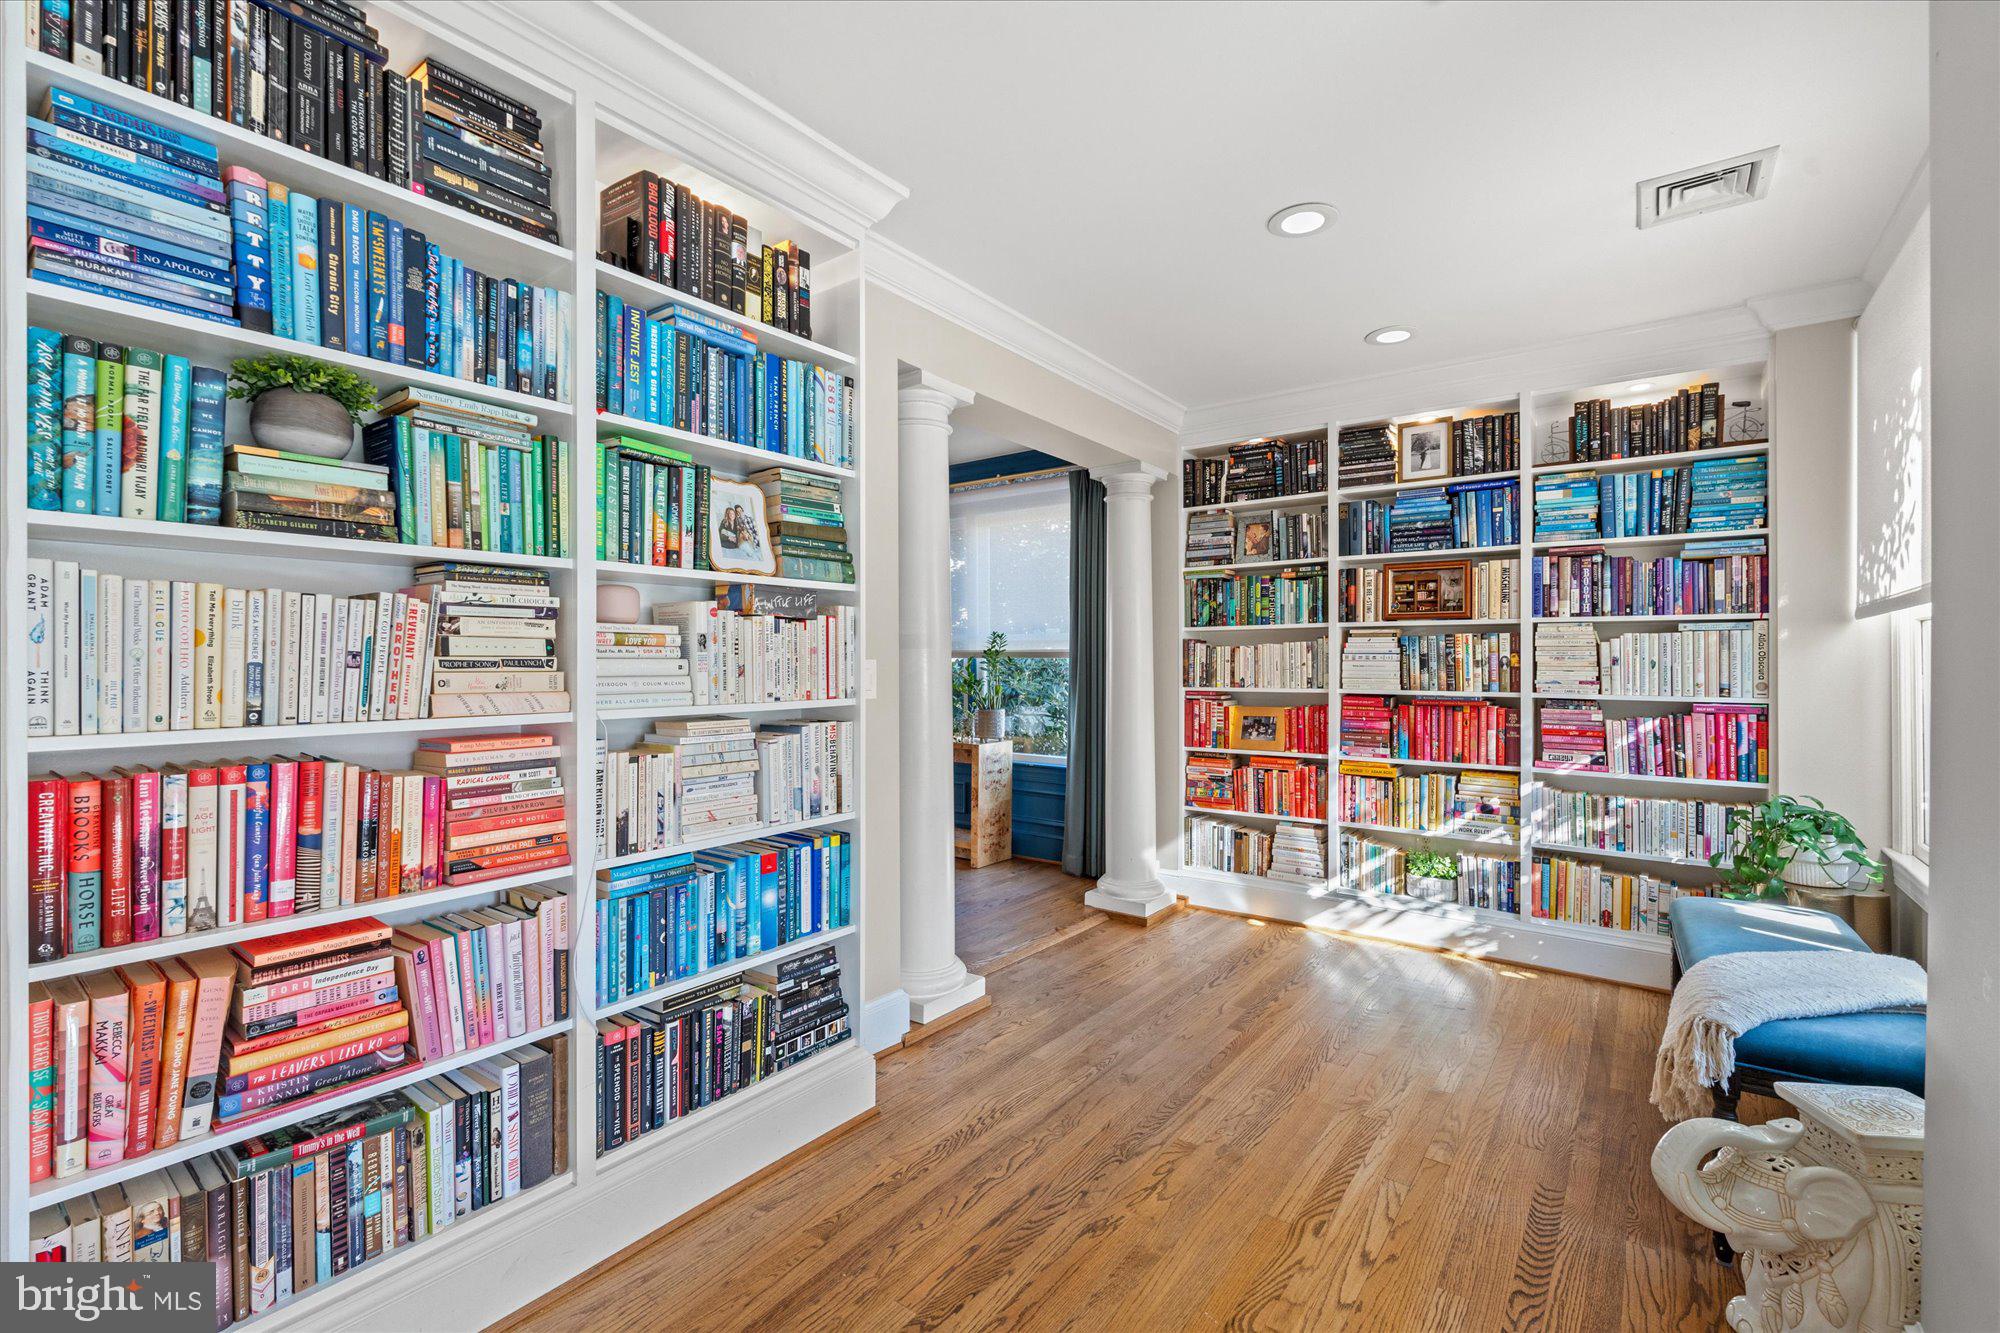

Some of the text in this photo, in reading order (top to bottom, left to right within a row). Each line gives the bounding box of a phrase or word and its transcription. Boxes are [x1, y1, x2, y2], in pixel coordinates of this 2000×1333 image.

[303, 50, 312, 81] TOLSTOY
[433, 165, 462, 186] Shuggie
[463, 179, 479, 192] Bain
[666, 183, 675, 207] CATCH
[648, 182, 658, 239] BAD BLOOD
[55, 233, 217, 280] ROMNEY NO APOLOGY
[75, 259, 134, 279] MURAKAMI
[329, 253, 339, 292] Chronic
[37, 339, 54, 370] ASK
[630, 309, 640, 384] INFINITE JEST
[137, 371, 149, 430] THE FAR FIELD
[196, 397, 219, 405] LIGHT
[416, 390, 479, 412] Sanctuary Emily
[827, 374, 835, 414] 1861
[192, 427, 221, 435] CANNOT
[135, 435, 147, 499] MADHURI VIJAY
[608, 462, 616, 515] TRUST
[290, 521, 317, 529] GILBERT
[656, 518, 665, 553] LEAVING
[27, 574, 36, 611] GRANT
[41, 577, 49, 608] ADAM
[1501, 567, 1510, 604] MISCHLING
[1582, 568, 1590, 612] BOOTH
[209, 602, 215, 611] Me
[232, 601, 243, 629] blink
[404, 609, 418, 659] REVENANT
[389, 623, 402, 704] BROTHER
[440, 660, 473, 668] PROPHET
[27, 671, 36, 705] AGAIN
[41, 671, 49, 704] THINK
[456, 774, 510, 785] RADICAL CANDOR
[482, 801, 545, 814] SILVER SPARROW
[74, 795, 90, 862] BROOKS
[192, 826, 215, 834] LIGHT
[614, 870, 631, 878] Maggie
[79, 877, 95, 929] HORSE
[267, 953, 287, 962] Keep
[270, 964, 379, 997] FORD Independence Day
[33, 1009, 50, 1039] TRUST
[112, 1021, 122, 1059] REBECCA
[95, 1021, 108, 1065] MAKKAI
[272, 1037, 383, 1079] LEAVERS LISA KO
[167, 1038, 186, 1120] YOUNG JANE YOUNG
[257, 1074, 310, 1095] KRISTIN
[315, 1065, 372, 1088] Great Alone
[92, 1092, 102, 1128] BELIEVERS
[105, 1094, 114, 1118] GREAT
[257, 1084, 310, 1106] HANNAH
[32, 1101, 49, 1158] SUSAN CHOI
[298, 1137, 326, 1155] Timmy's
[347, 1128, 360, 1141] Well
[217, 1193, 227, 1260] WARLIGHT
